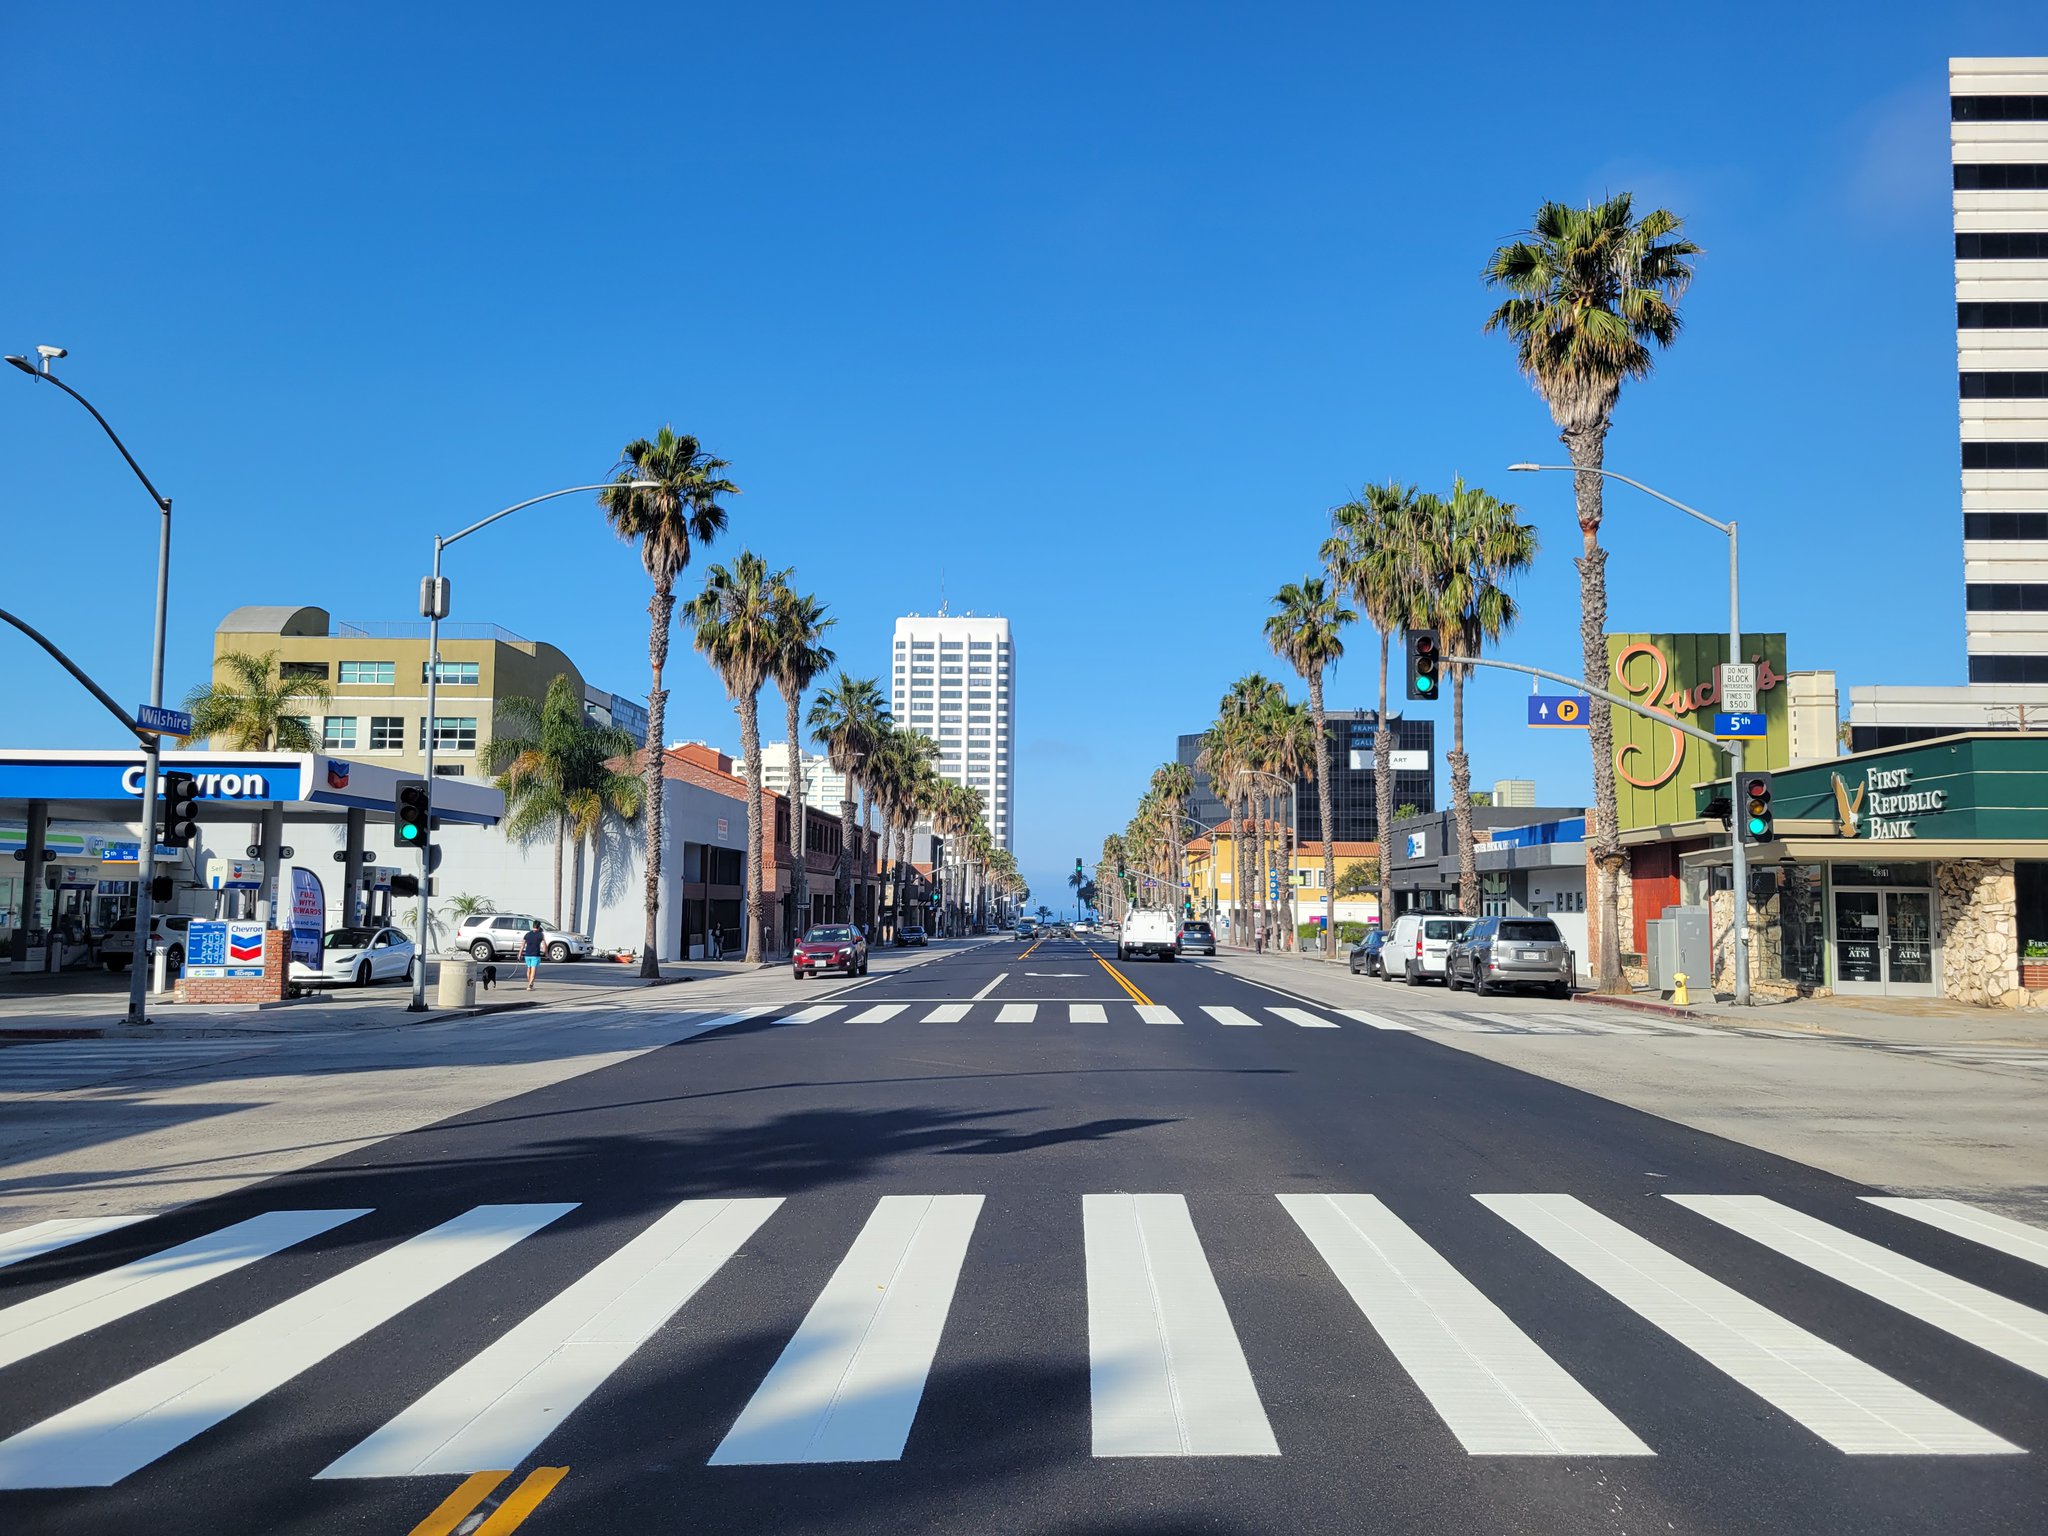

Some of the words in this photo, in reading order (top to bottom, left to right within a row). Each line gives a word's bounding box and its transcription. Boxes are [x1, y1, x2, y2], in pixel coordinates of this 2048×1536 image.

[1727, 675, 1749, 683] BLOCK
[1729, 700, 1748, 709] $500
[1564, 704, 1574, 717] P
[141, 707, 189, 730] Wilshire
[1730, 716, 1751, 731] 5th
[121, 766, 263, 796] Cvron
[1866, 767, 1908, 791] FIRST
[1868, 790, 1943, 815] REPUBLIC
[1869, 817, 1911, 839] BANK
[104, 850, 117, 859] 5th
[251, 864, 256, 873] 3
[299, 891, 316, 899] FUEL
[299, 899, 316, 908] WITH
[231, 925, 263, 933] Chevron
